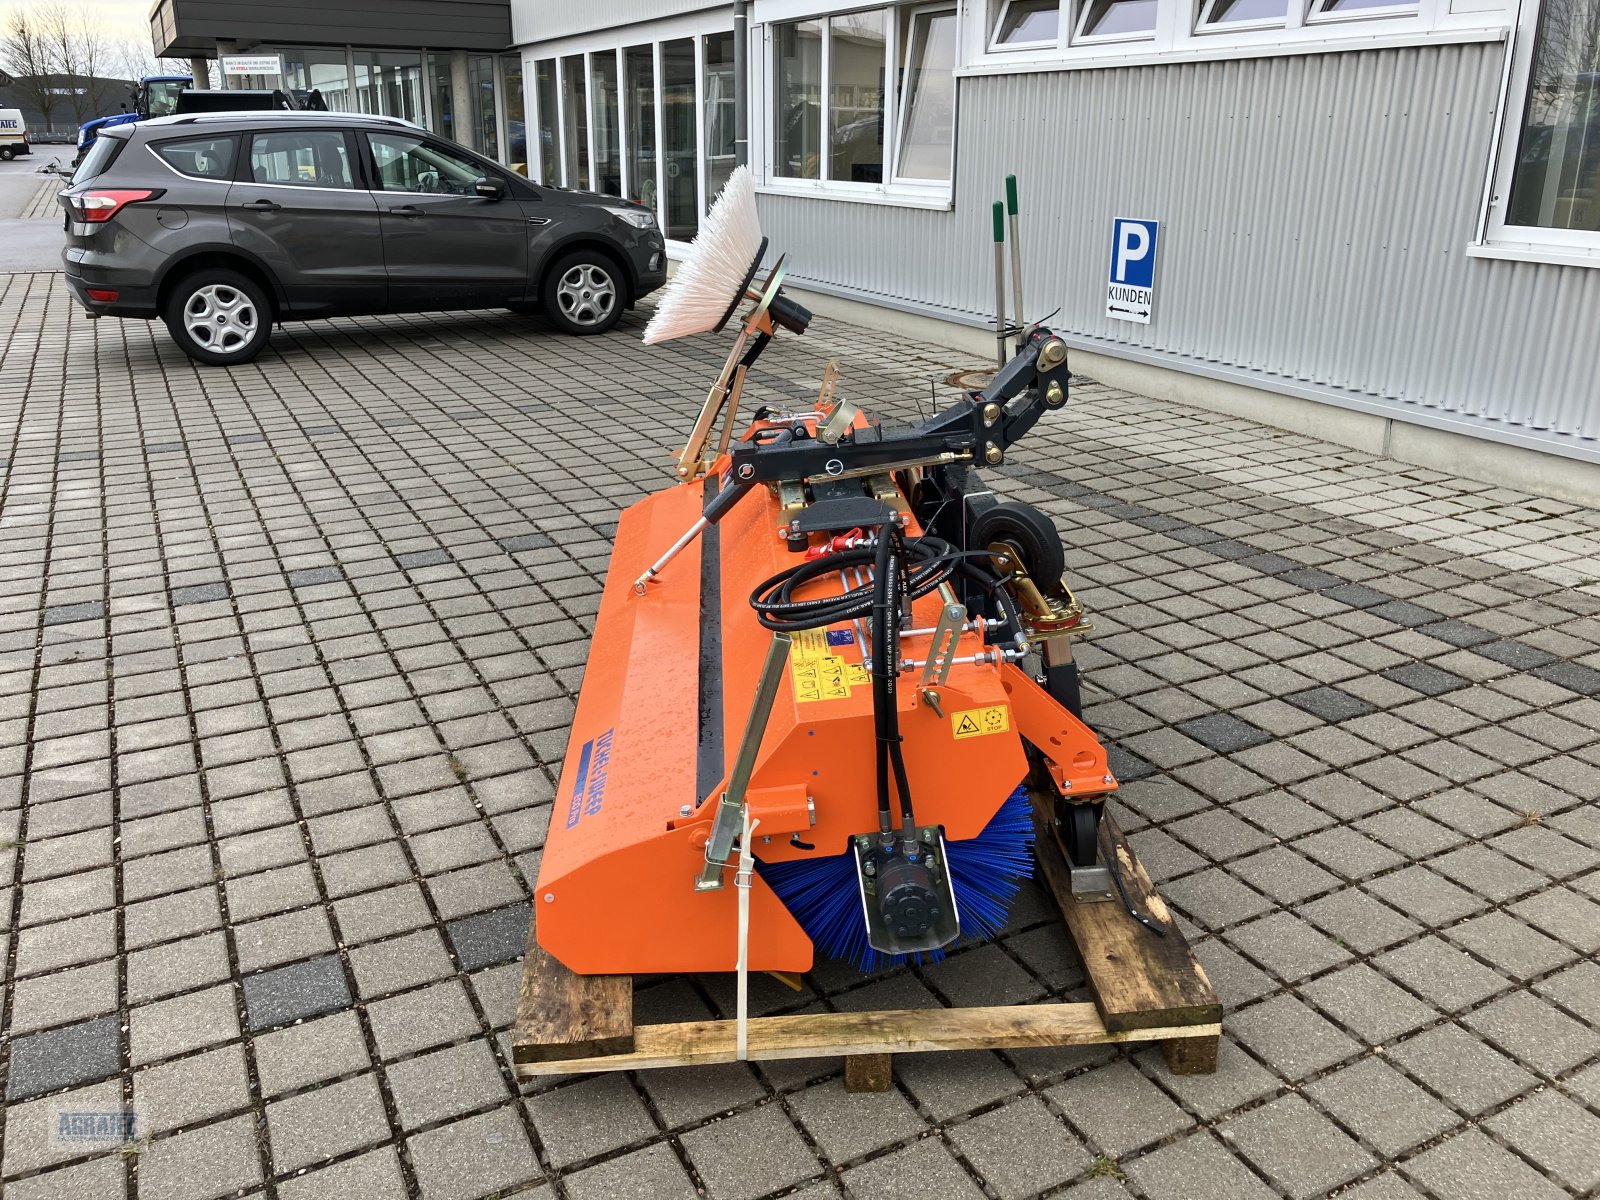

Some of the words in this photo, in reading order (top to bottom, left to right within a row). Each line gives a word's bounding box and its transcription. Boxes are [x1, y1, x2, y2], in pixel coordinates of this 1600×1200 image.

[0, 119, 17, 128] ATEC
[1116, 222, 1150, 281] P
[1108, 286, 1151, 305] KUNDEN
[887, 644, 892, 655] WP
